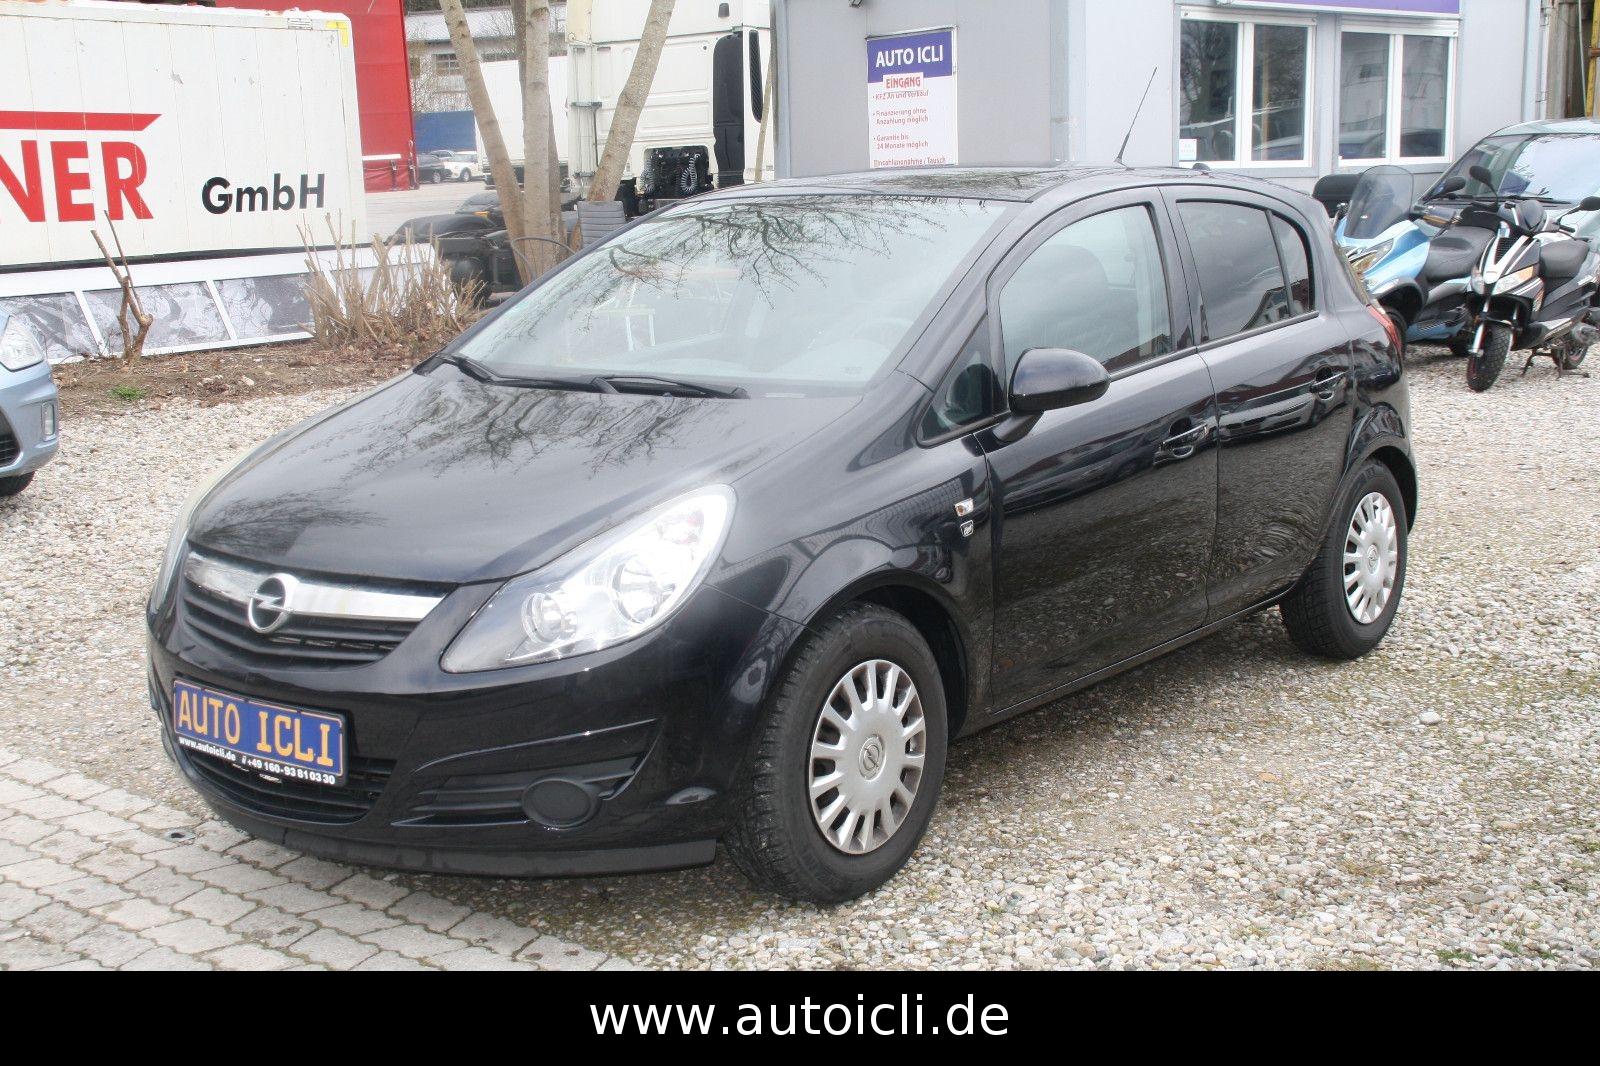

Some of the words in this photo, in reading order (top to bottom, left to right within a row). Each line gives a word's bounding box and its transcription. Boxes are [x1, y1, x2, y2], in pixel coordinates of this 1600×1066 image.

[876, 48, 914, 67] AUTO
[917, 45, 944, 63] ICLI
[885, 76, 921, 89] EINGANG
[876, 109, 912, 117] Finanzierung
[877, 117, 906, 125] Anzahlung
[877, 134, 900, 142] Garantie
[907, 141, 929, 149] möglich
[202, 173, 325, 215] GmbH
[178, 690, 241, 745] AUTO
[256, 711, 334, 767] ICLI
[178, 737, 237, 762] www.autoicli.de
[247, 758, 263, 769] +49
